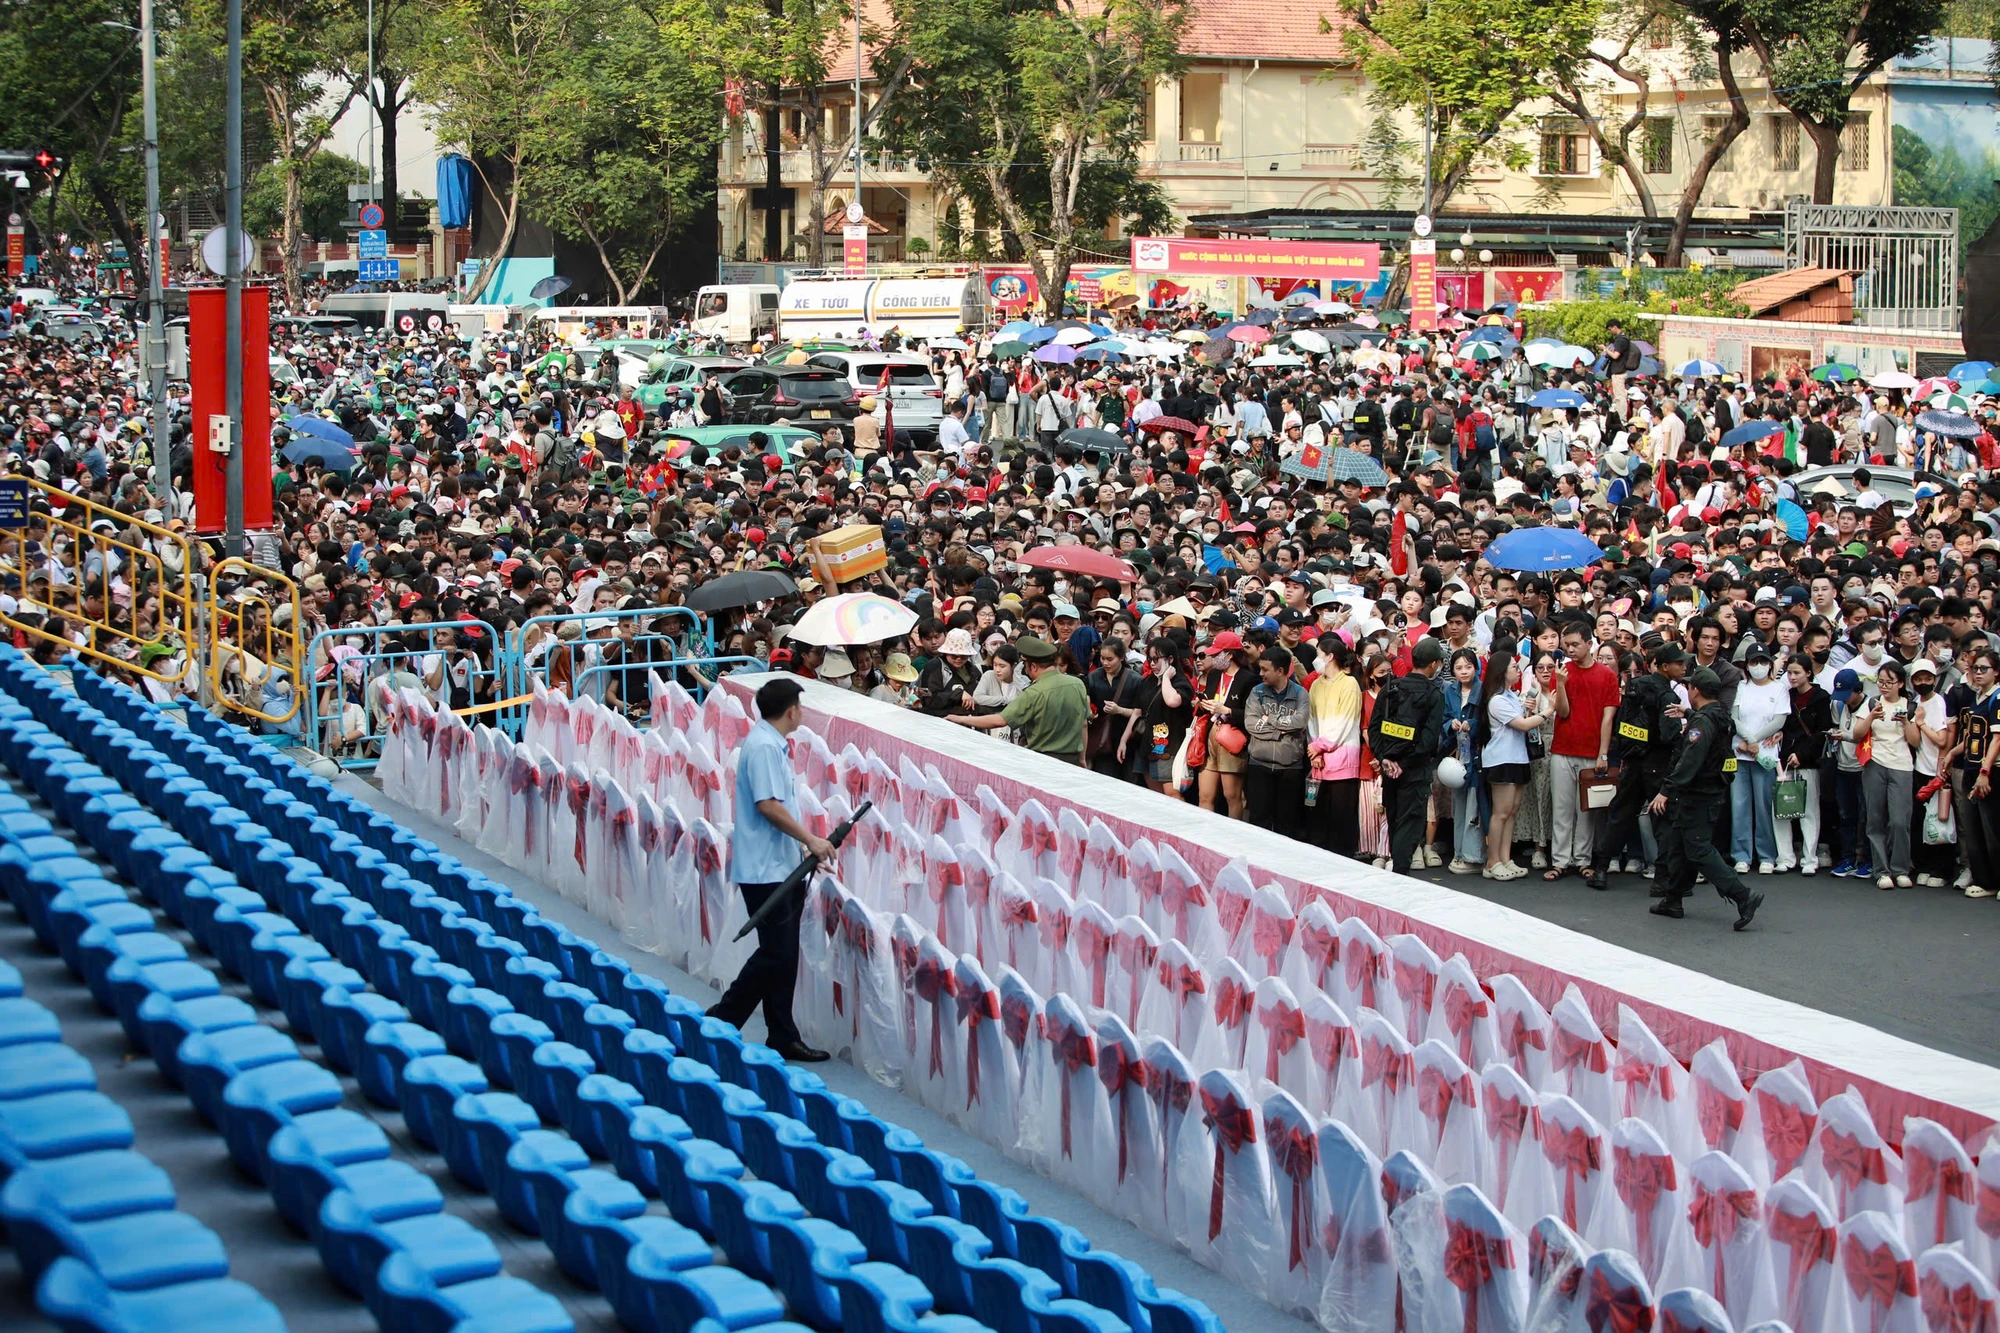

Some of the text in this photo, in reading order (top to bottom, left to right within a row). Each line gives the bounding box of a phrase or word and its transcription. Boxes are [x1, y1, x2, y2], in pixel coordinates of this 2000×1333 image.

[795, 298, 810, 309] XE
[882, 294, 918, 308] CÔNG
[921, 293, 951, 307] VIÊN
[1965, 714, 1987, 763] 8
